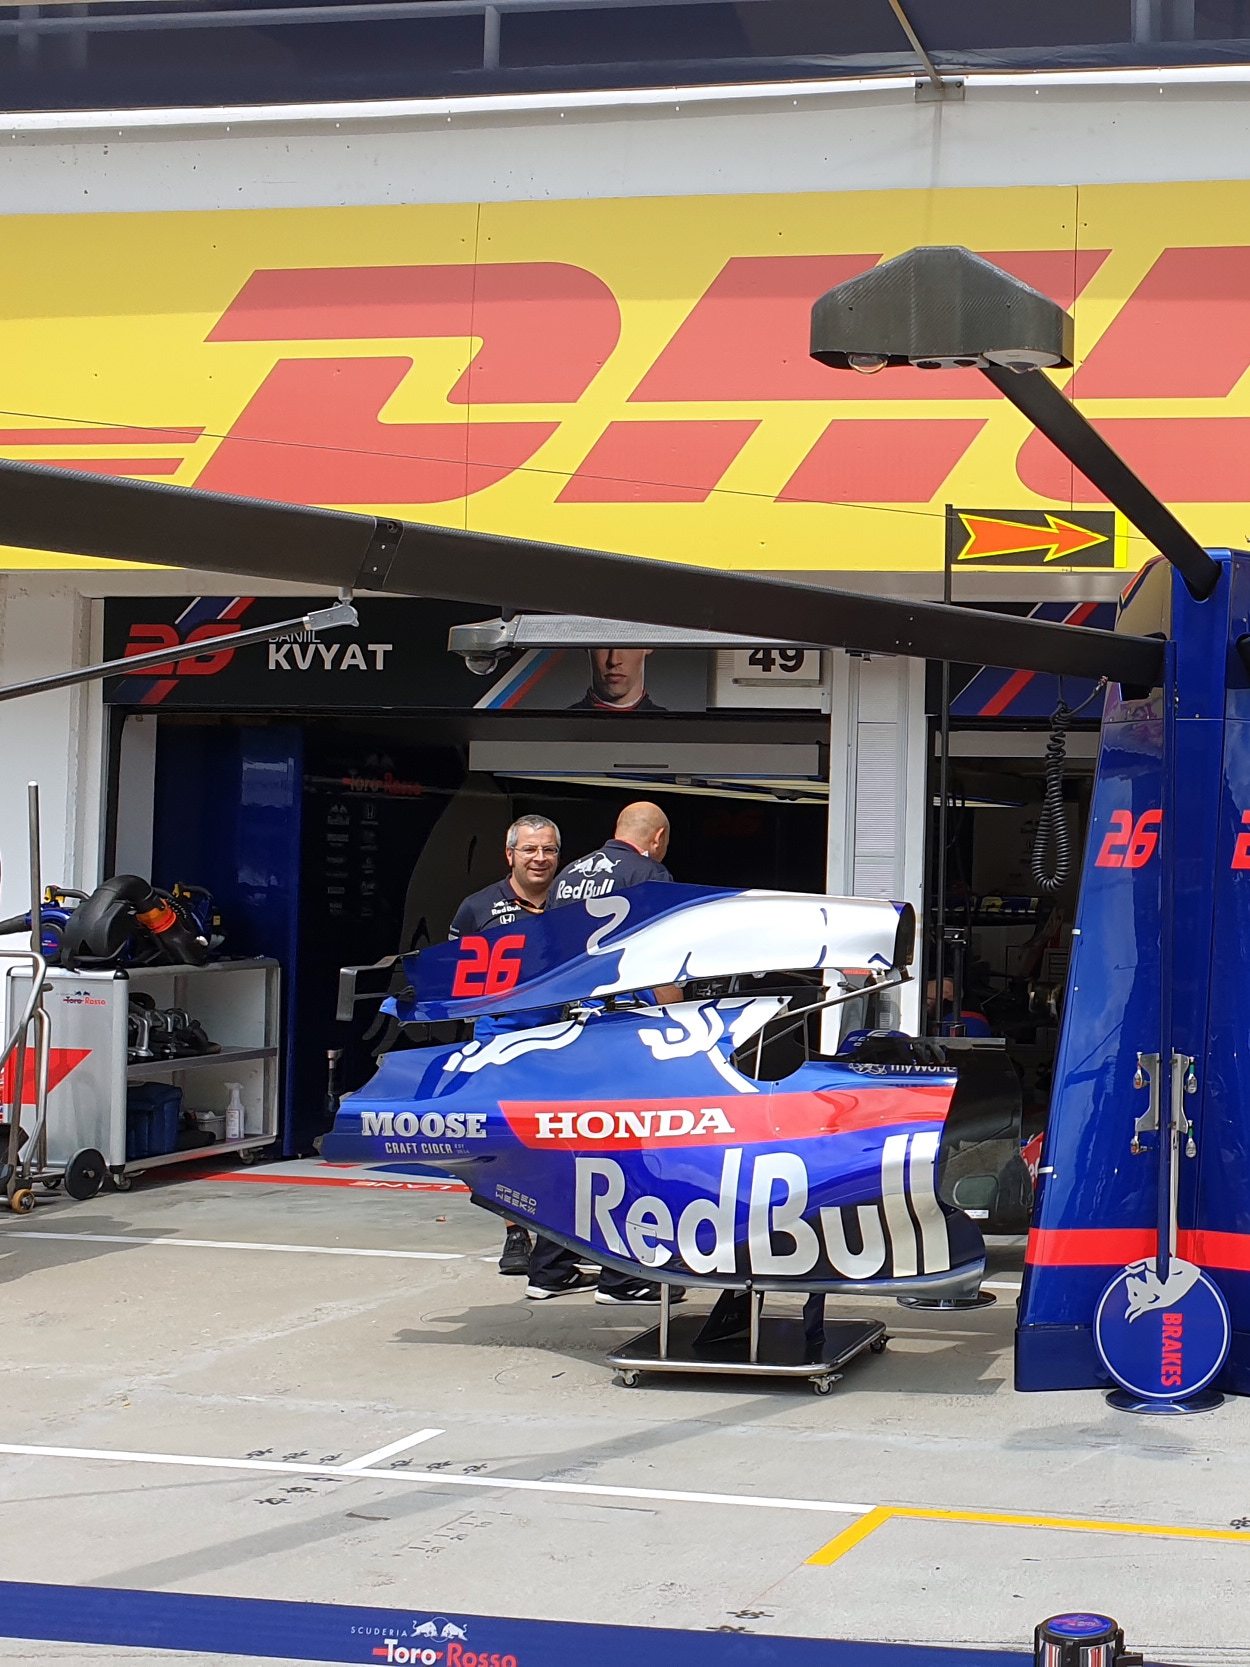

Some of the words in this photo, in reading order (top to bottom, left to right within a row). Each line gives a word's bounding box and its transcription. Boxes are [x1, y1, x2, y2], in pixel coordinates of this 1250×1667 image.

[122, 623, 242, 676] 26
[268, 644, 393, 671] KVYAT
[748, 648, 804, 673] 49
[1094, 809, 1163, 869] 26
[451, 934, 527, 997] 26
[361, 1111, 488, 1139] MOOSE
[534, 1107, 735, 1140] HONDA
[385, 1142, 418, 1154] CRAFT
[421, 1143, 454, 1155] CIDER
[496, 1183, 538, 1206] SPEED
[1160, 1312, 1184, 1388] BRAKES
[350, 1626, 408, 1638] SCUDERIA
[383, 1638, 437, 1666] Toro
[446, 1642, 518, 1667] Rosso
